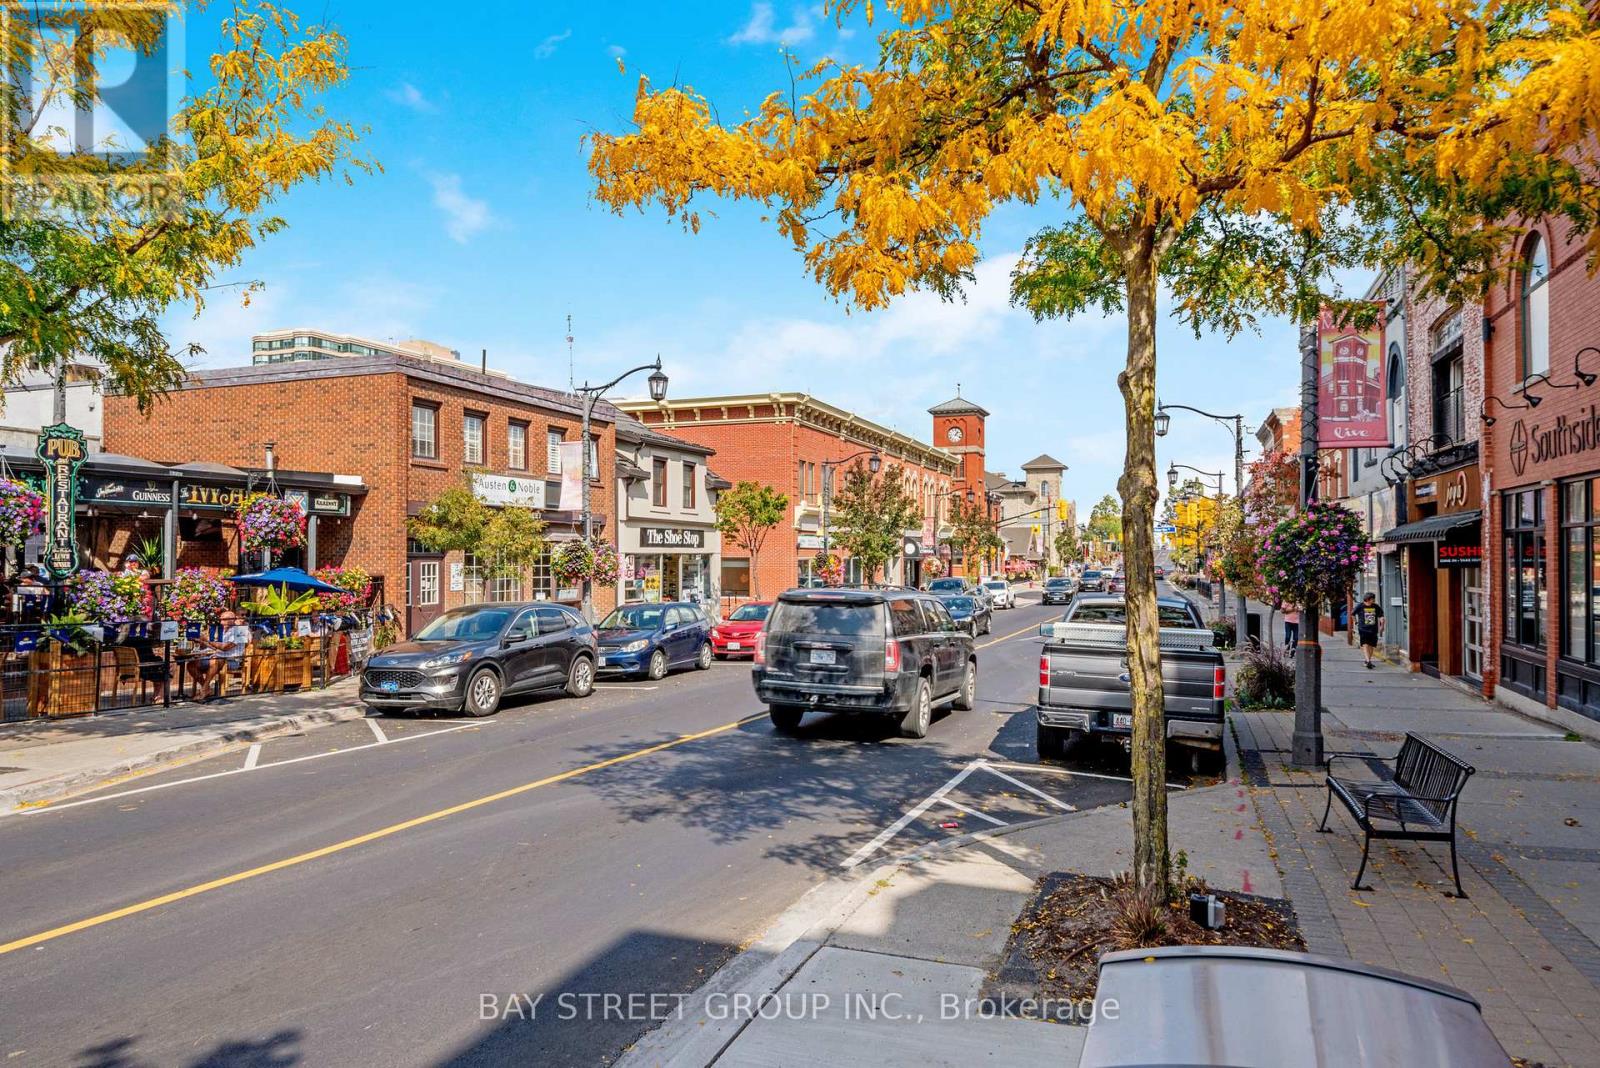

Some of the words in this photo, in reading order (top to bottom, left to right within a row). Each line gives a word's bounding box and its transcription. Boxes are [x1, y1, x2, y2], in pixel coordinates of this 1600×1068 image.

[1334, 426, 1370, 439] Live
[47, 438, 81, 458] PUB
[479, 478, 507, 491] Austen
[518, 483, 541, 495] Noble
[56, 464, 70, 546] RESTAURANT
[132, 490, 171, 502] GUINNESS
[647, 528, 664, 544] The
[664, 529, 683, 544] Shoe
[683, 530, 700, 548] Stop
